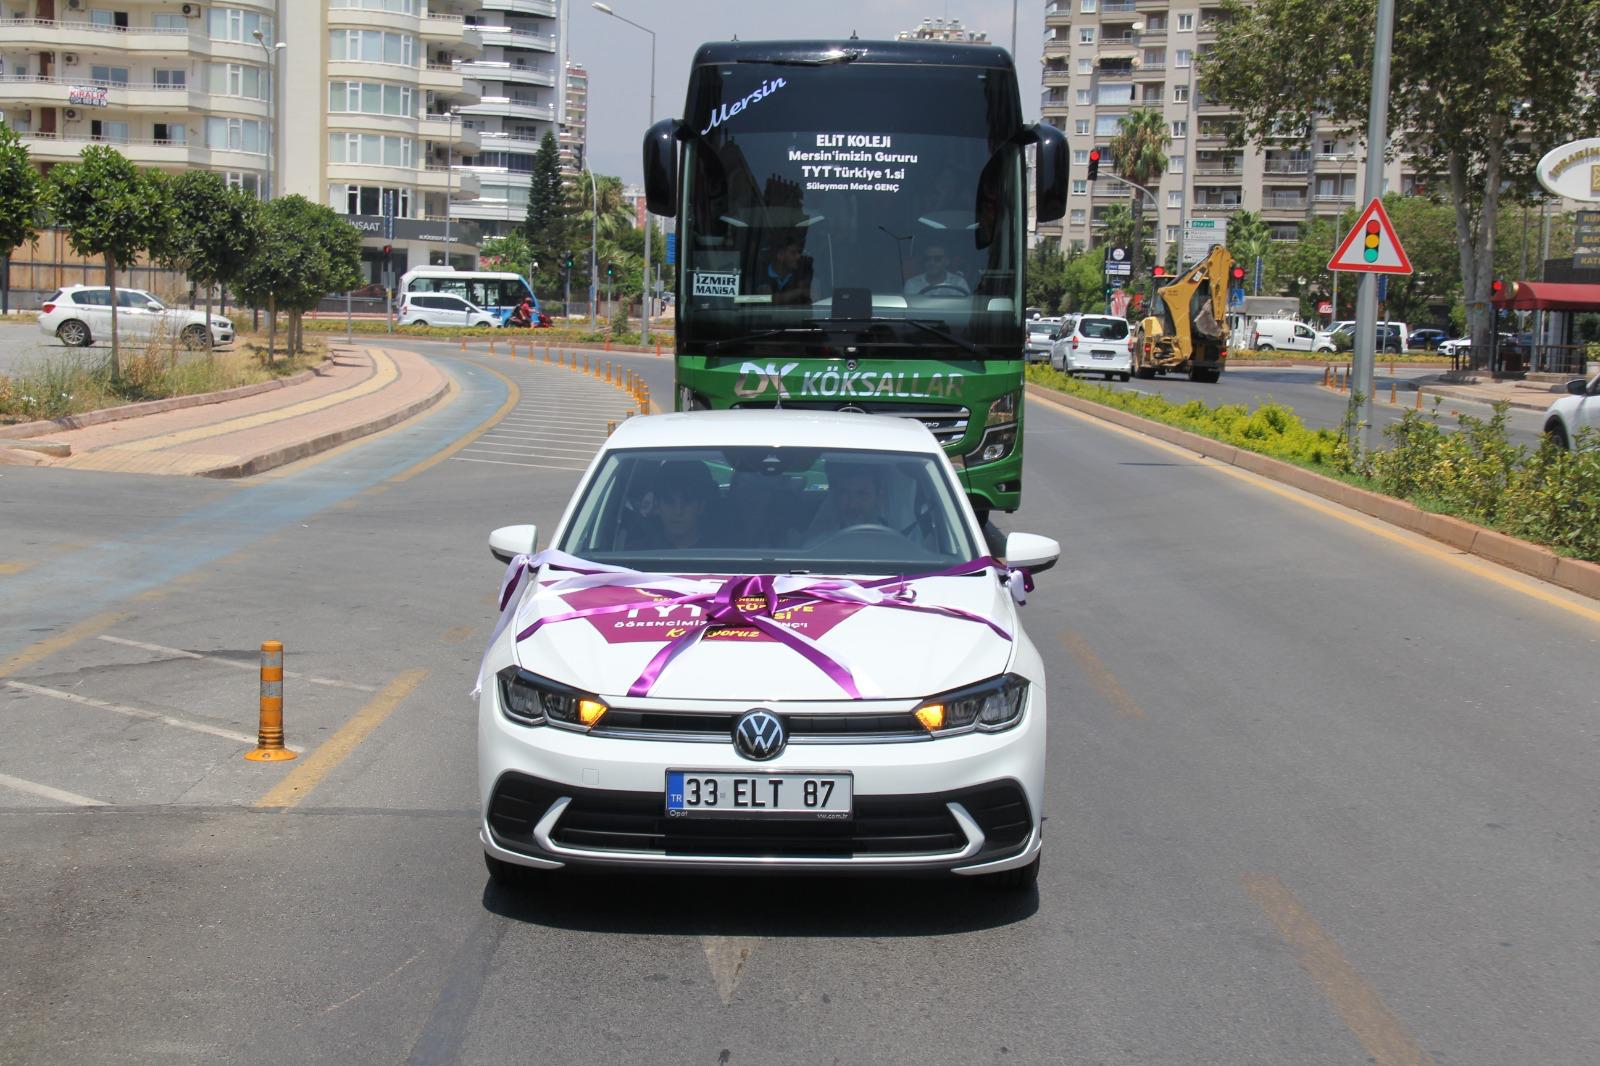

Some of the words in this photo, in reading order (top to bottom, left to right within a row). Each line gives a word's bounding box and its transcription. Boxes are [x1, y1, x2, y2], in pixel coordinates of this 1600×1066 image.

[701, 77, 787, 136] Mersin
[875, 152, 918, 163] Gururu
[801, 165, 833, 178] TYT
[834, 167, 882, 181] Türkiye
[884, 168, 905, 180] 1.si
[806, 182, 848, 192] Süleyman
[850, 183, 873, 191] Mete
[874, 184, 900, 193] GENÇ
[801, 366, 965, 398] KÖKSALLAR
[671, 794, 682, 802] TR
[686, 778, 718, 806] 33
[733, 779, 784, 807] ELT
[803, 780, 835, 807] 87
